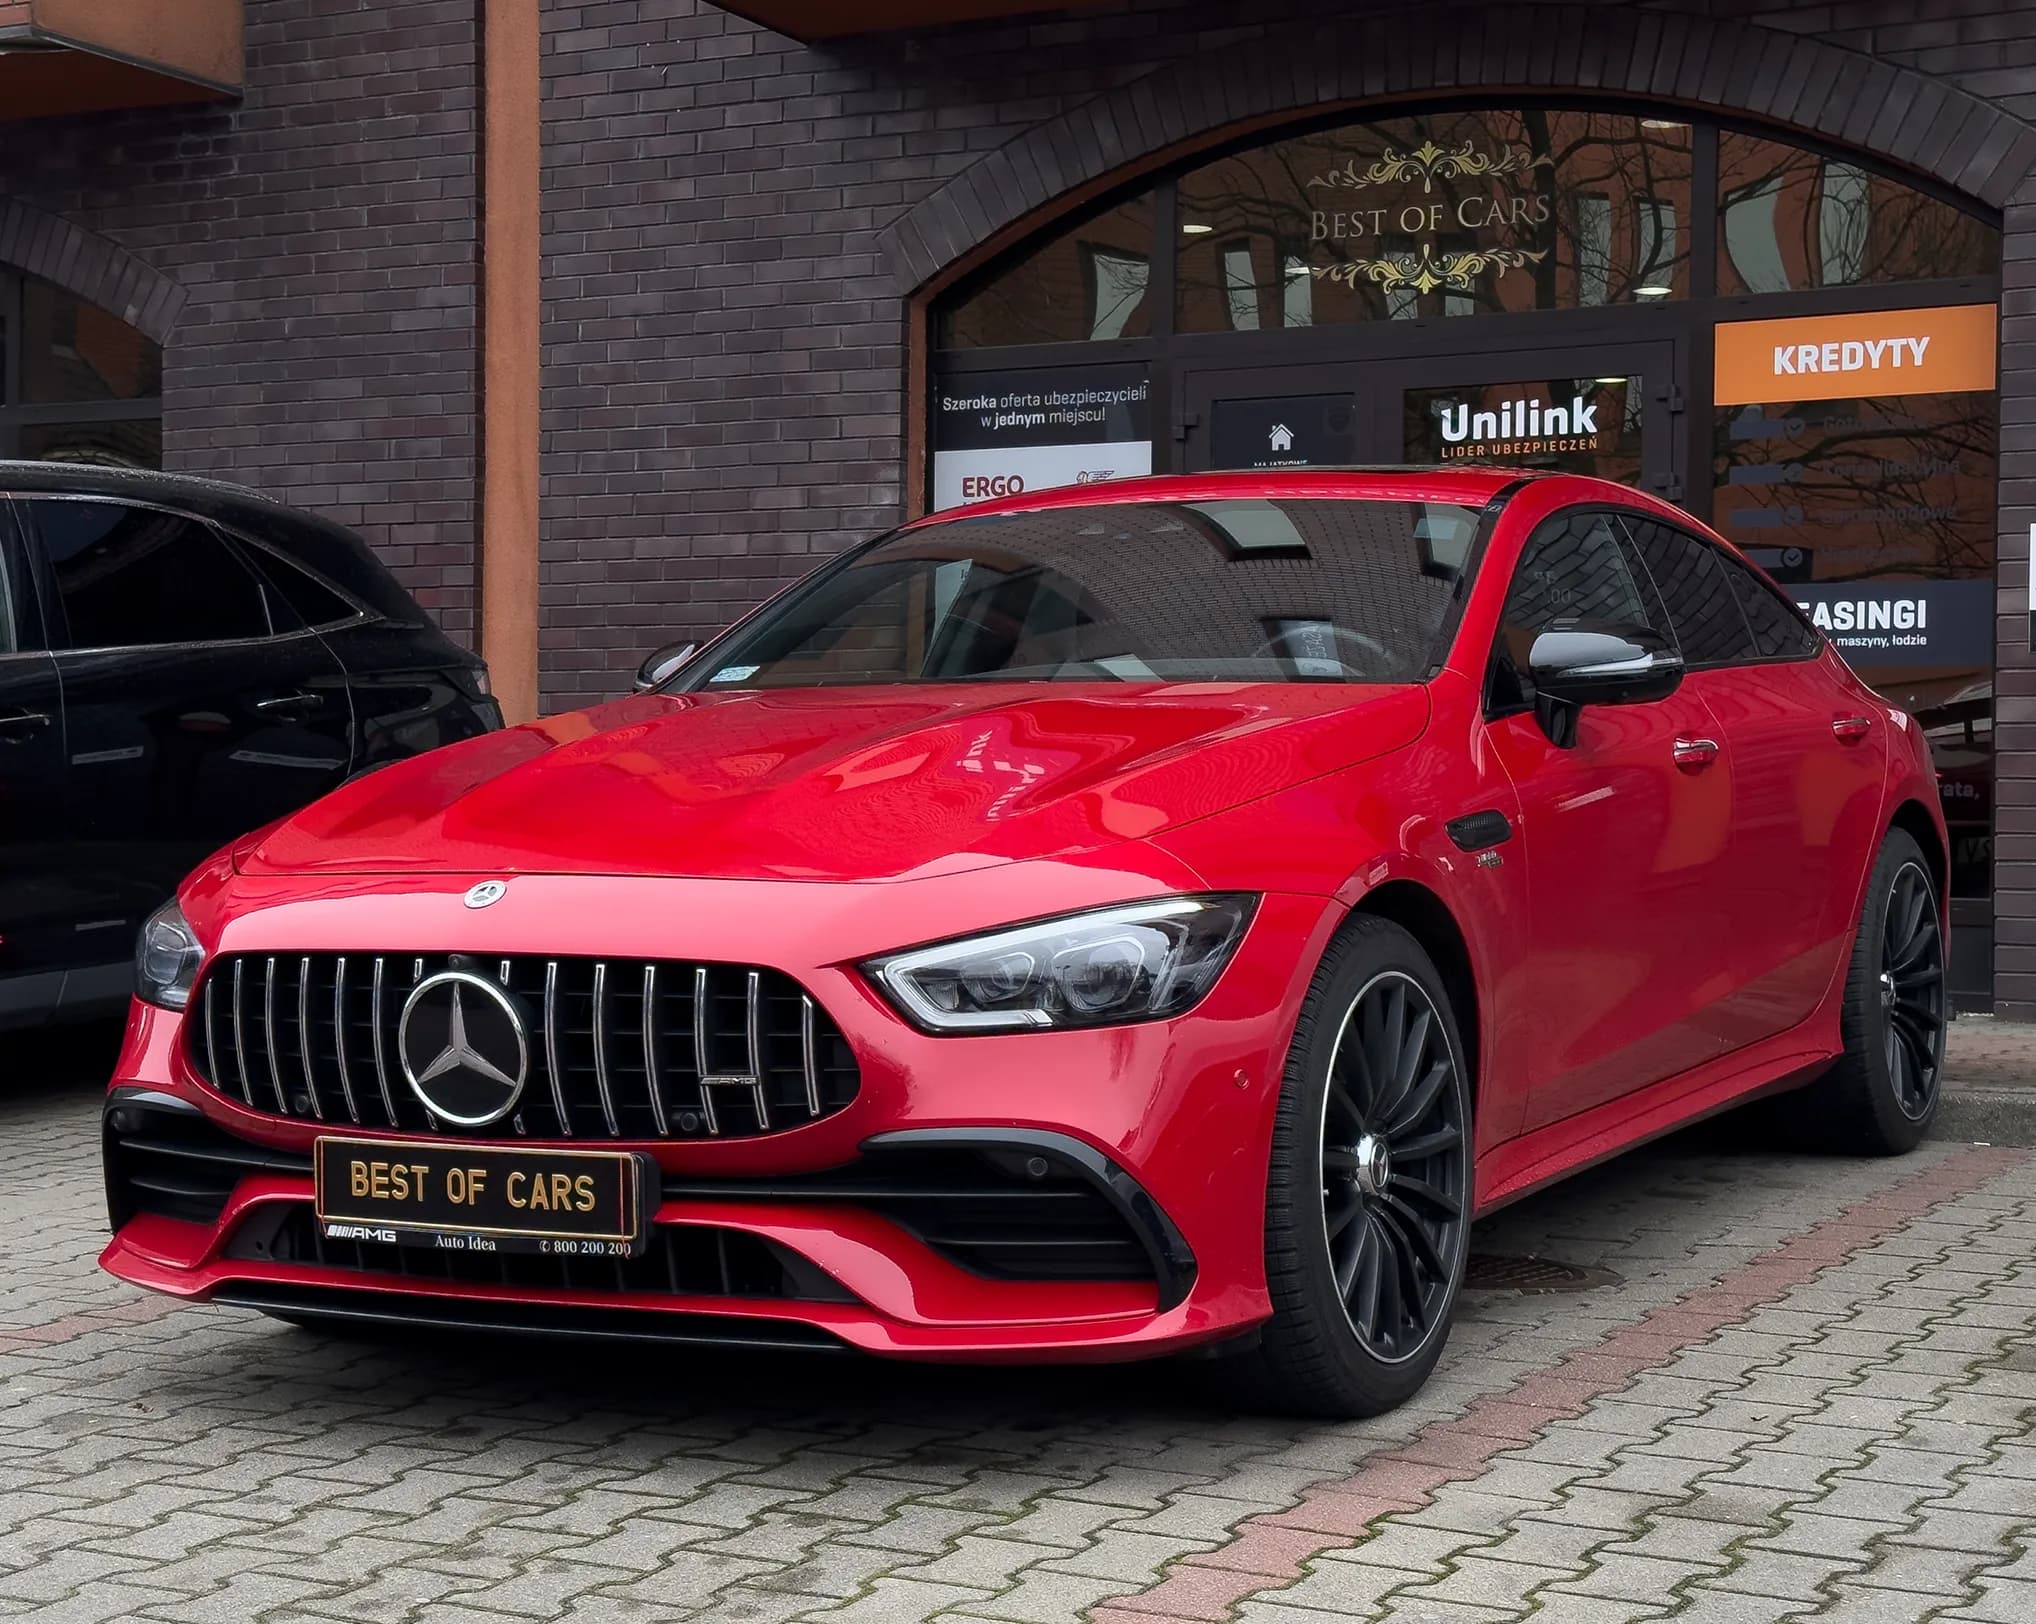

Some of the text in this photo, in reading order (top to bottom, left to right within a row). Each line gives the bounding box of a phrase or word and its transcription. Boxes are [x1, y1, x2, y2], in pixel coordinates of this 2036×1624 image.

[1773, 336, 1930, 375] KREDYTY
[943, 384, 1147, 411] Szeroka oferta ubezpieczycieli
[981, 406, 1106, 430] w jednym miejscu!
[1441, 396, 1598, 442] Unilink
[1441, 435, 1598, 458] LIDER UBEZPIECZEŃ
[962, 475, 1024, 498] ERGO
[1836, 636, 1889, 648] maszyny,
[1892, 633, 1928, 646] łodzie
[351, 1160, 596, 1212] BEST OF CARS
[435, 1235, 497, 1251] Auto Idea
[554, 1240, 632, 1255] 800 200 200
